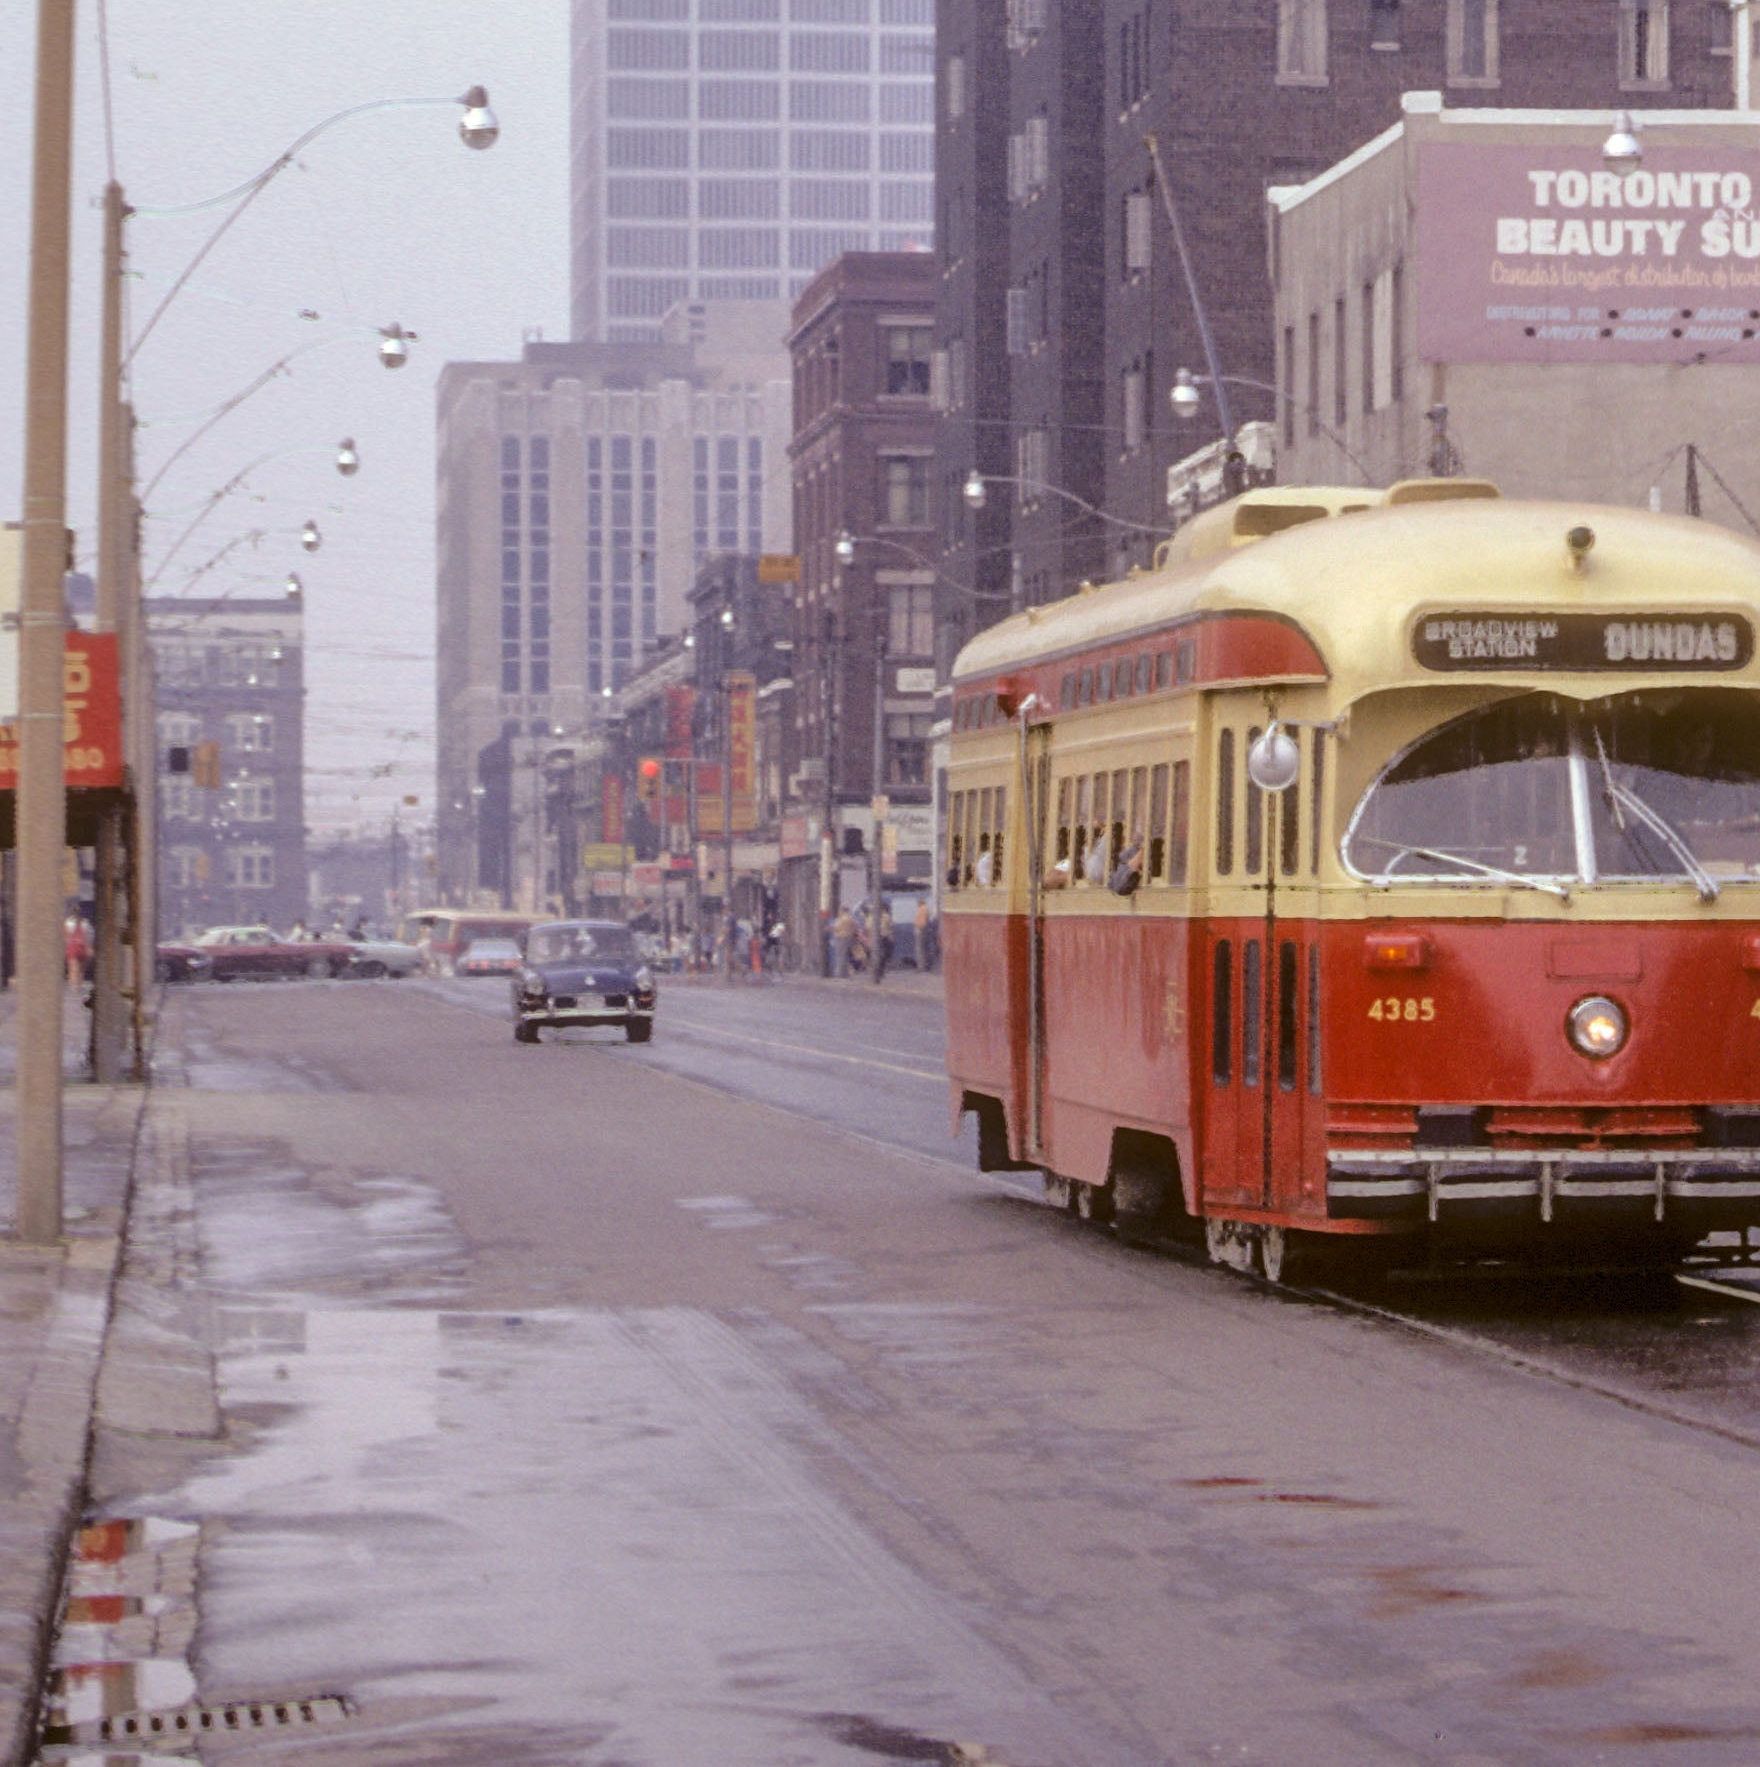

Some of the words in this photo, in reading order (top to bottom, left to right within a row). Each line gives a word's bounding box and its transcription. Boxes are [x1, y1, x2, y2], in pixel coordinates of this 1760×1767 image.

[1529, 171, 1751, 208] TORONTO
[1496, 218, 1685, 256] BEAUTY
[1425, 620, 1558, 641] BROADVIEW
[1603, 622, 1737, 661] DUNDAS
[1449, 639, 1536, 658] STATION
[1368, 998, 1435, 1022] 4385
